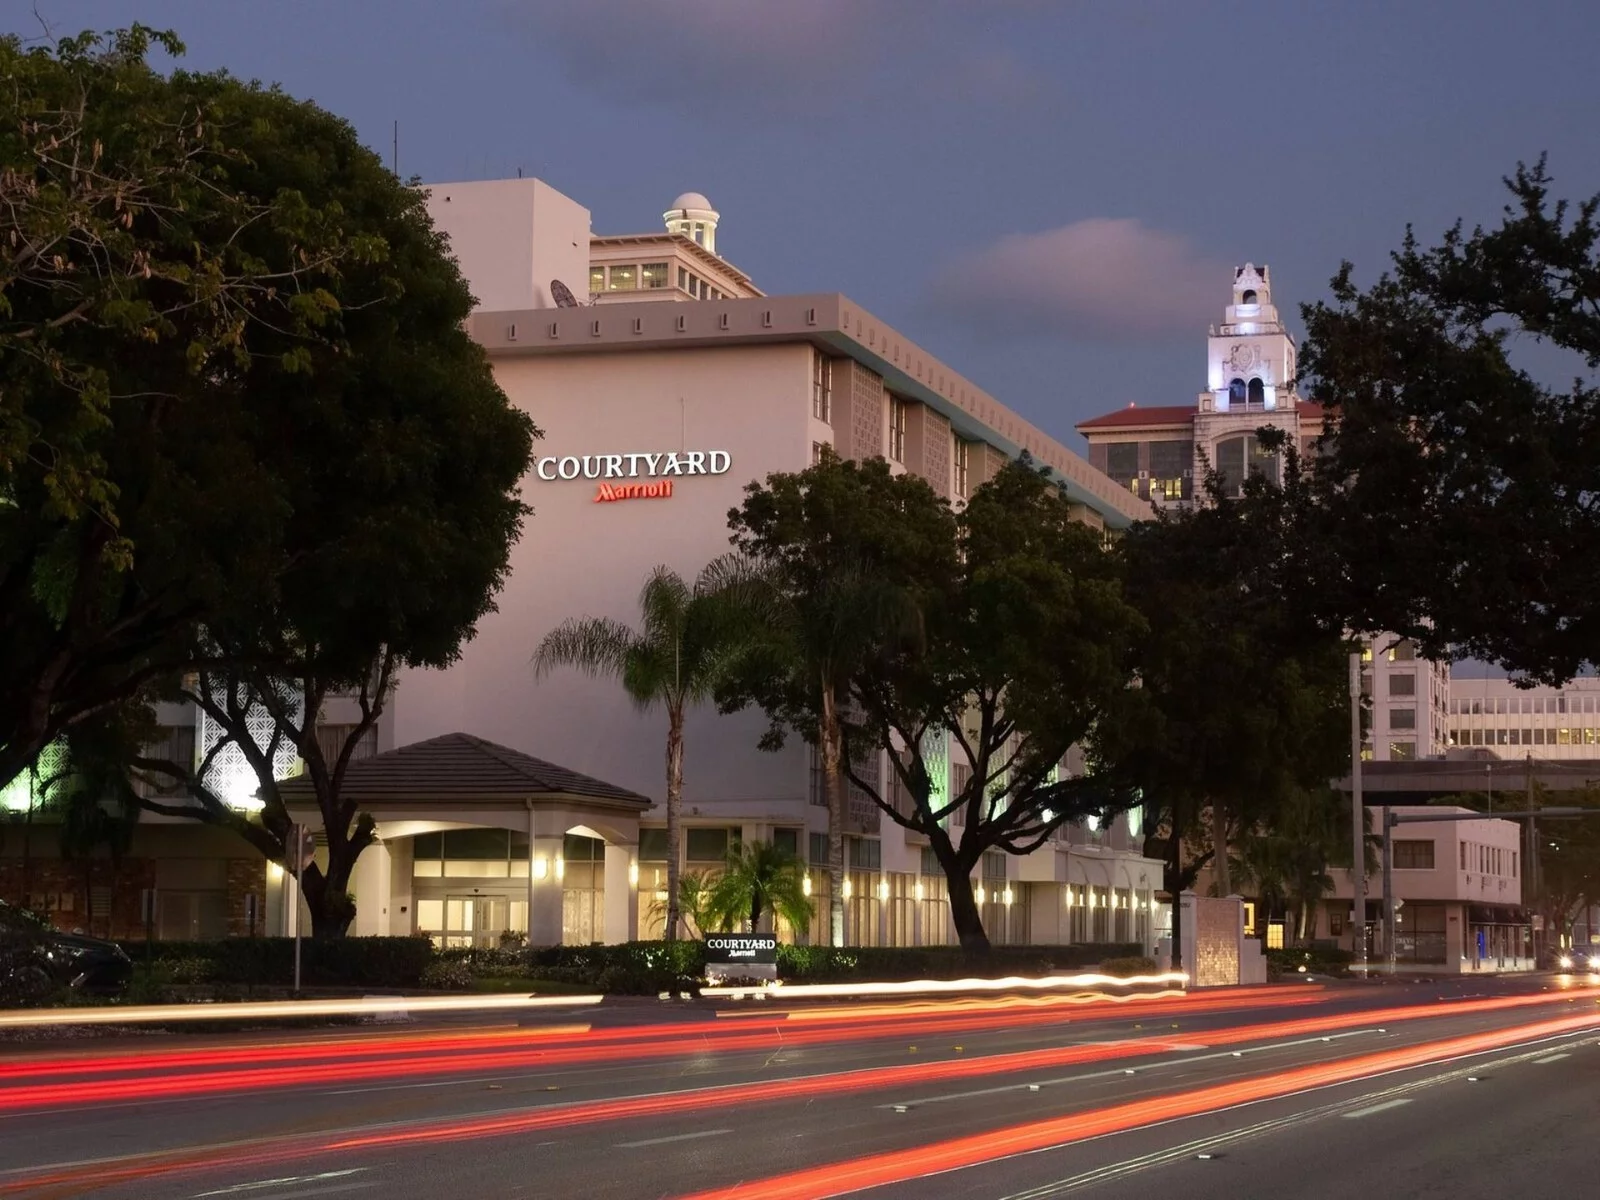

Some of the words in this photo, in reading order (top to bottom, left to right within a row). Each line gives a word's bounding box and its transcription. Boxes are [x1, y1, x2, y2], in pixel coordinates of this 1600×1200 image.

[537, 450, 731, 481] COURTYARD
[593, 480, 673, 503] Marriott
[707, 939, 776, 949] COURTYARD
